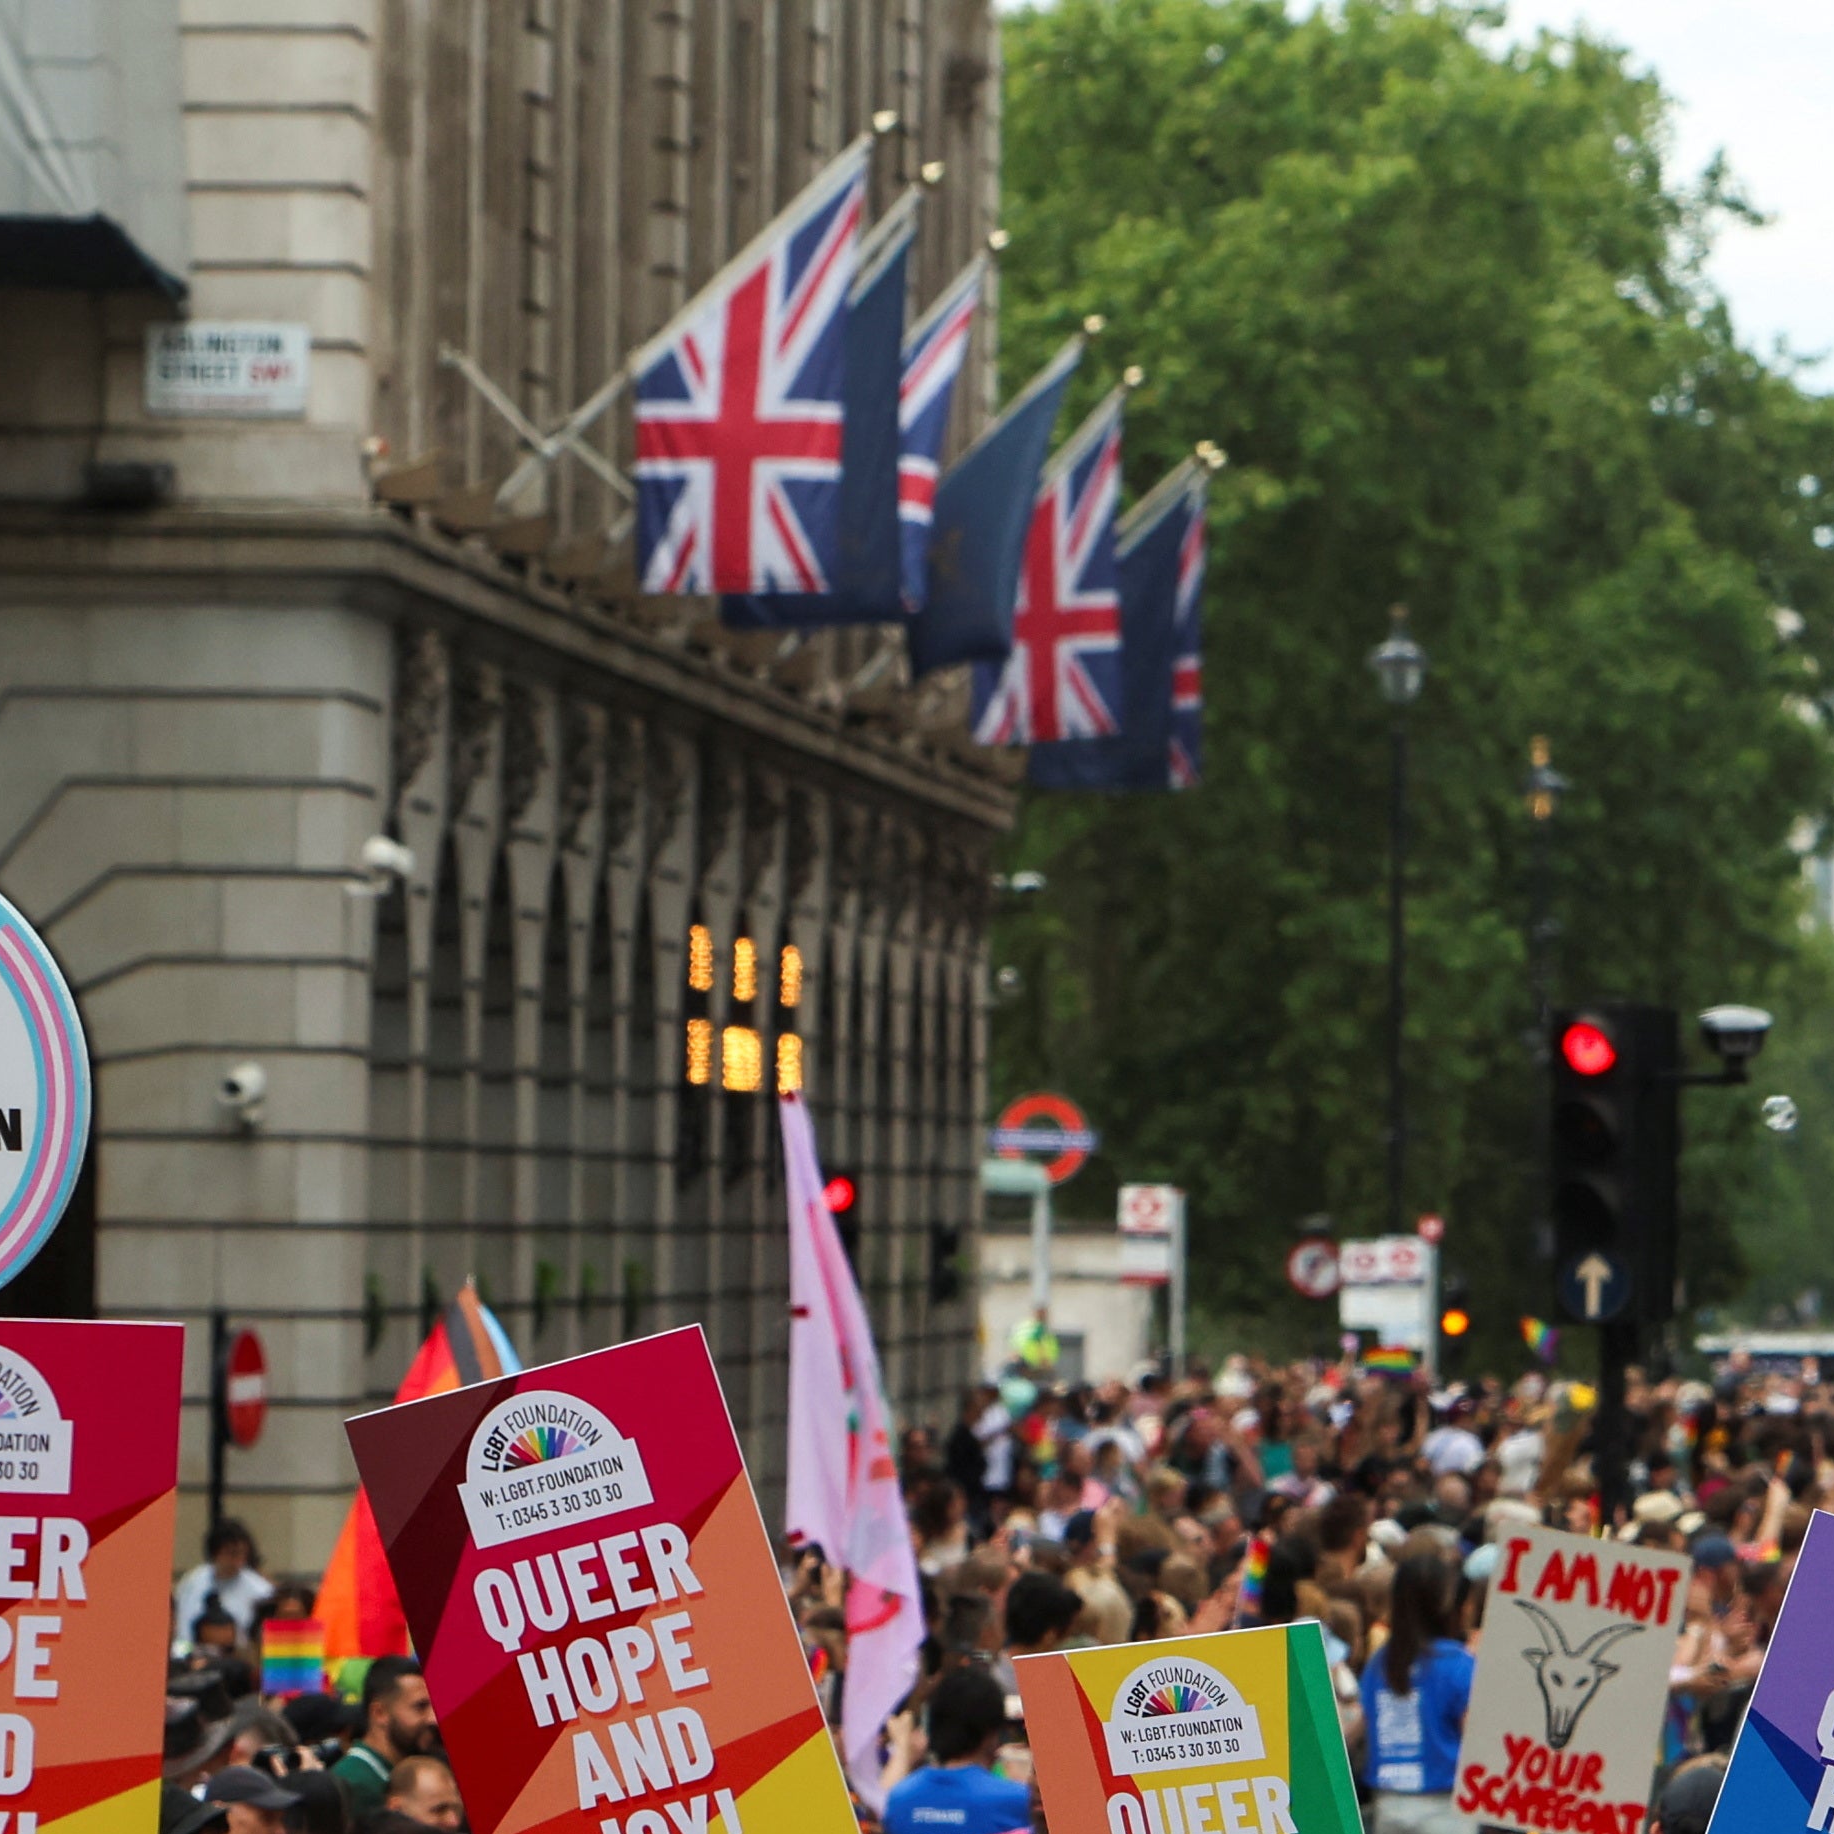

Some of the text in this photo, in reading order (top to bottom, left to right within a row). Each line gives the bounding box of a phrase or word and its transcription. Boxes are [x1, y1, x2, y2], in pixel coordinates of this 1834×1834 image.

[481, 1404, 603, 1472] LGBT FOUNDATION
[19, 1462, 38, 1480] 30
[480, 1456, 624, 1508] W: LGBT.FOUNDATION
[496, 1483, 622, 1530] T: 0345 3 30 30 30
[473, 1522, 703, 1652] QUEER
[1498, 1537, 1681, 1626] I AM NOT
[517, 1611, 709, 1727] HOPE
[1124, 1667, 1229, 1716] LGBT FOUNDATION
[573, 1706, 715, 1811] AND
[1121, 1717, 1243, 1744] W: LGBT.FOUNDATION
[1132, 1739, 1239, 1763] T: 0345 3 30 30 30
[1501, 1732, 1605, 1794] YOUR
